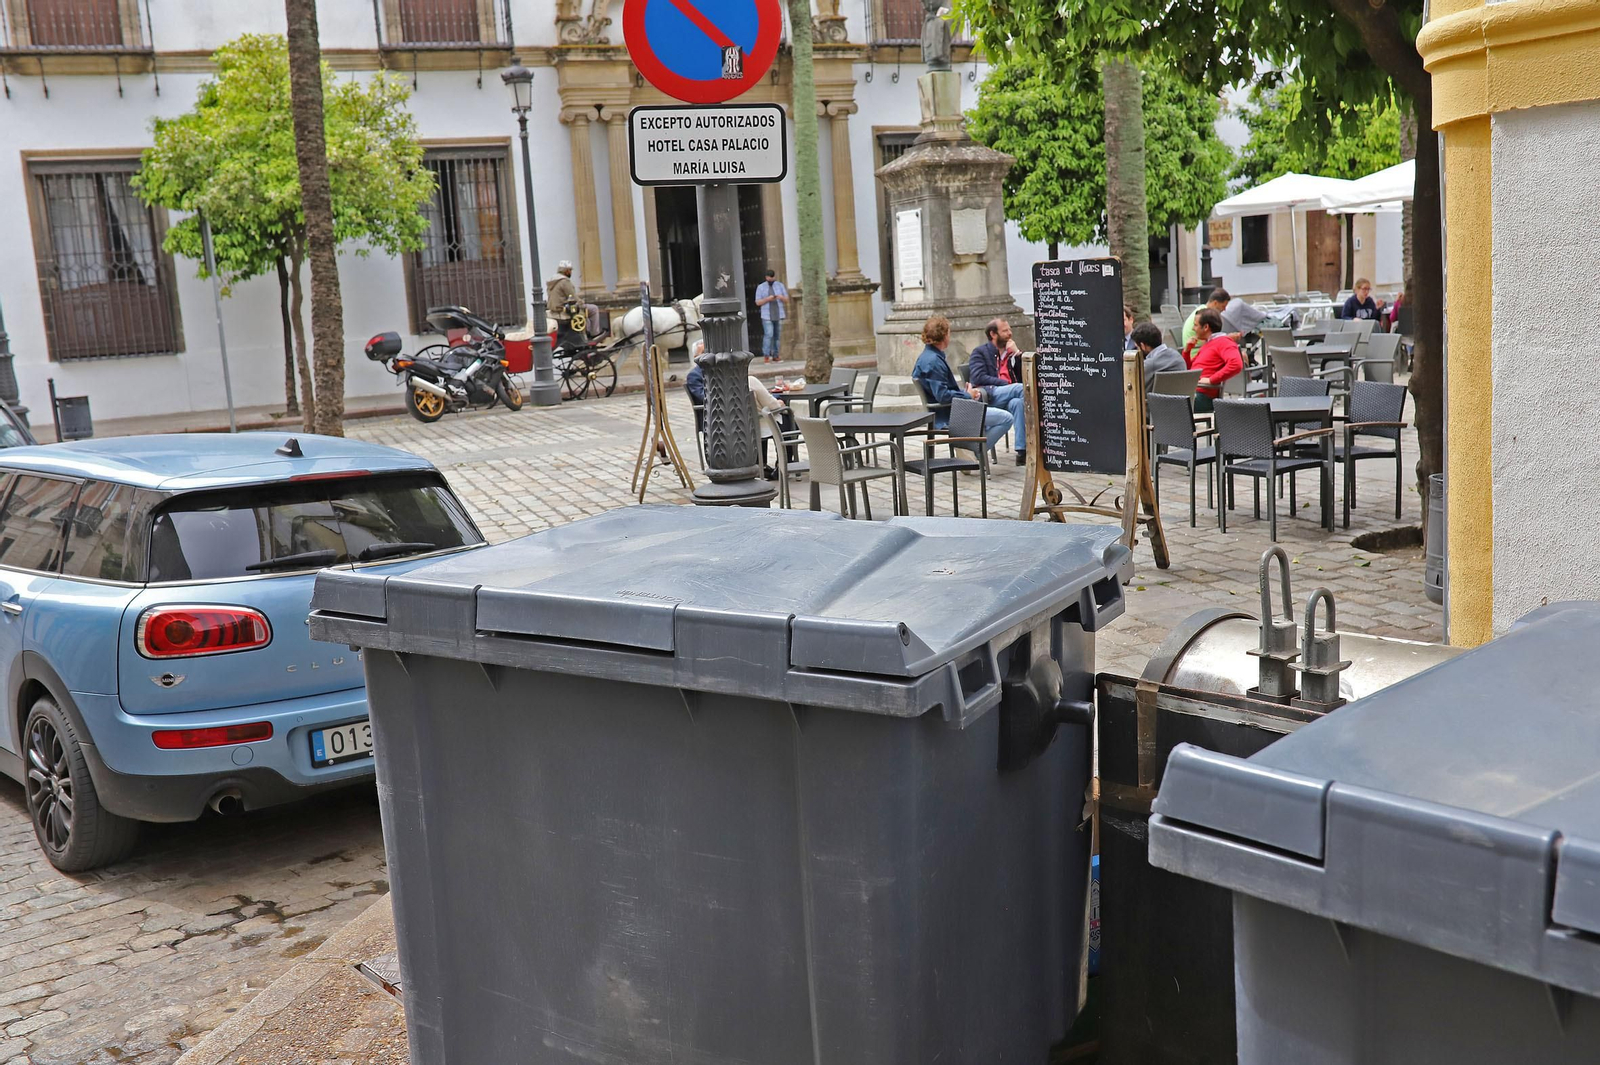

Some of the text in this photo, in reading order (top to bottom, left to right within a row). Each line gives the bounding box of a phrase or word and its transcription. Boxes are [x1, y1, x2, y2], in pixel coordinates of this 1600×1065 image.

[640, 115, 775, 129] EXCEPTO AUTORIZADOS
[648, 138, 769, 152] HOTEL CASA PALACIO
[673, 159, 746, 174] MARÍA LUISA
[331, 724, 373, 754] 013
[316, 749, 323, 757] E
